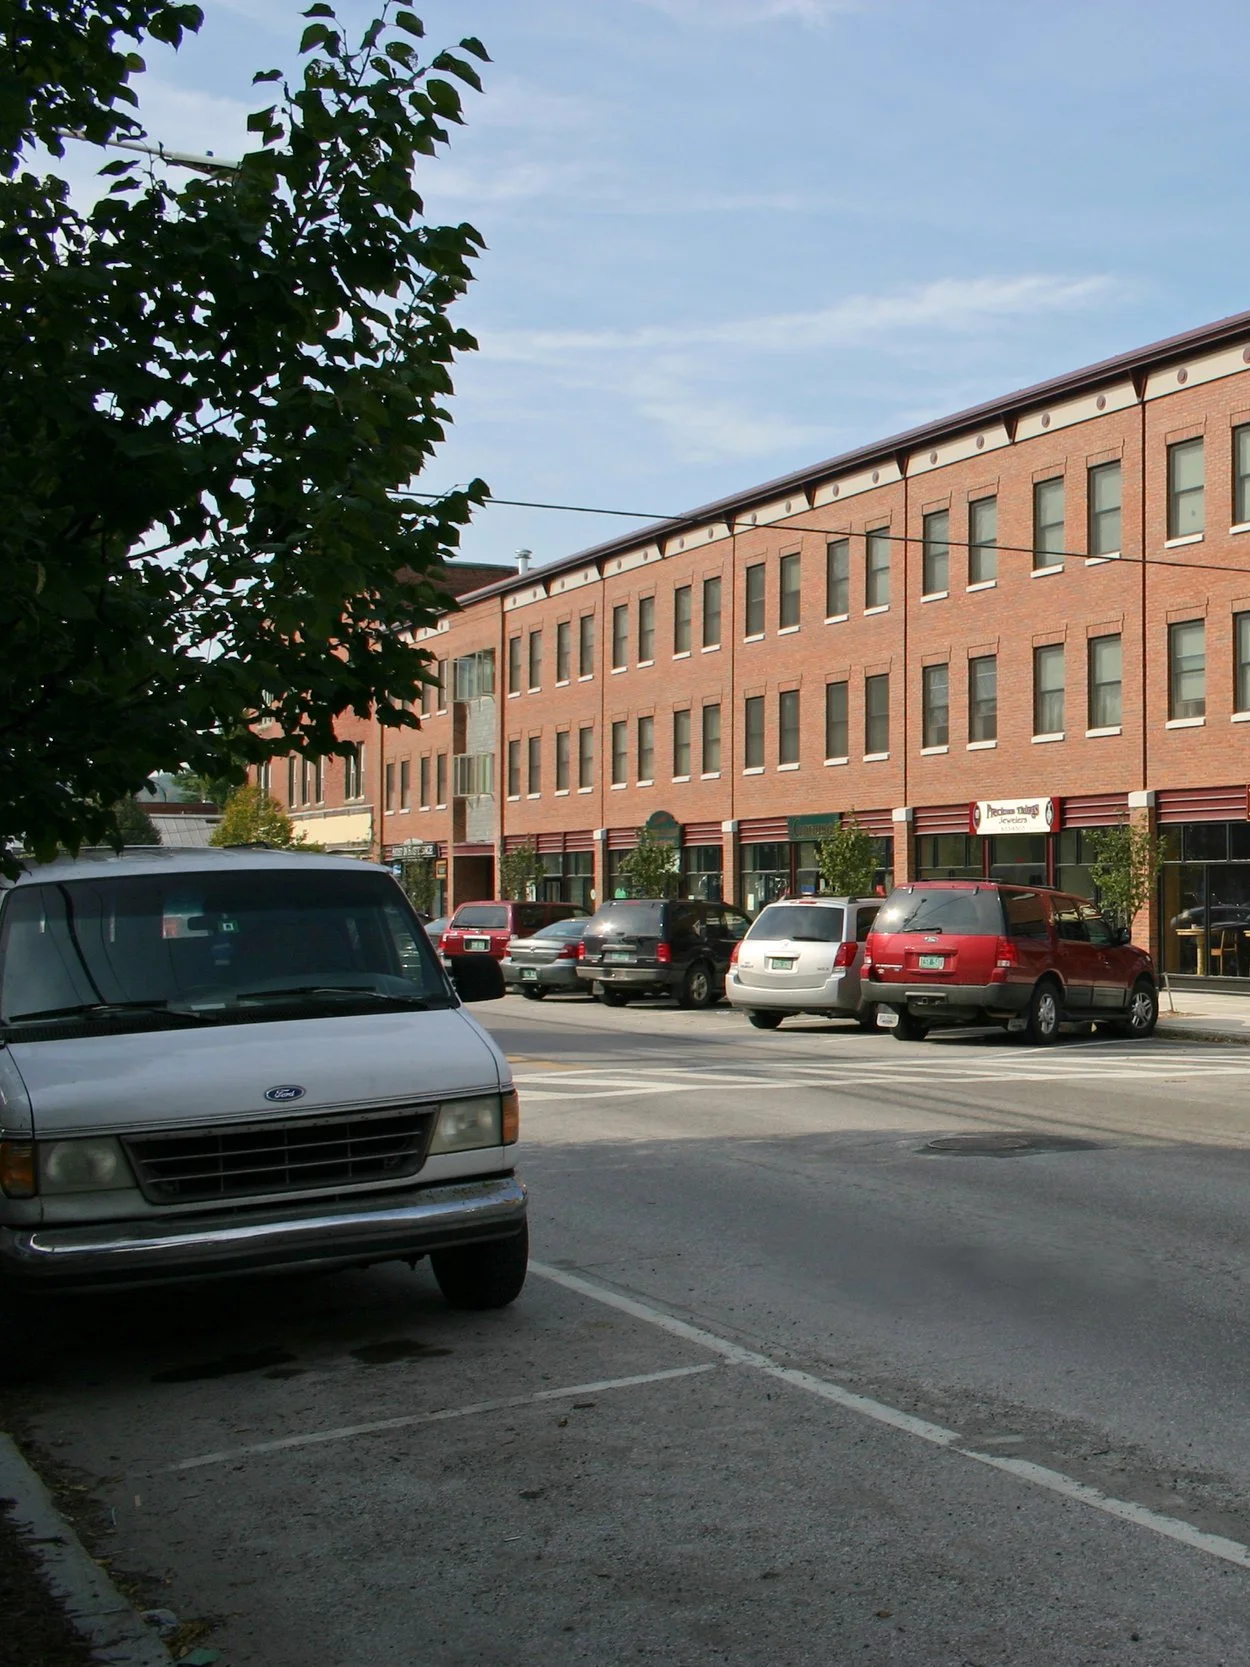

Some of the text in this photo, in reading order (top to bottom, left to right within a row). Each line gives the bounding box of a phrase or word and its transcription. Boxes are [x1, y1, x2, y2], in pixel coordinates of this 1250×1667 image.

[986, 803, 1039, 819] Precious Things
[274, 1089, 296, 1098] Ford
